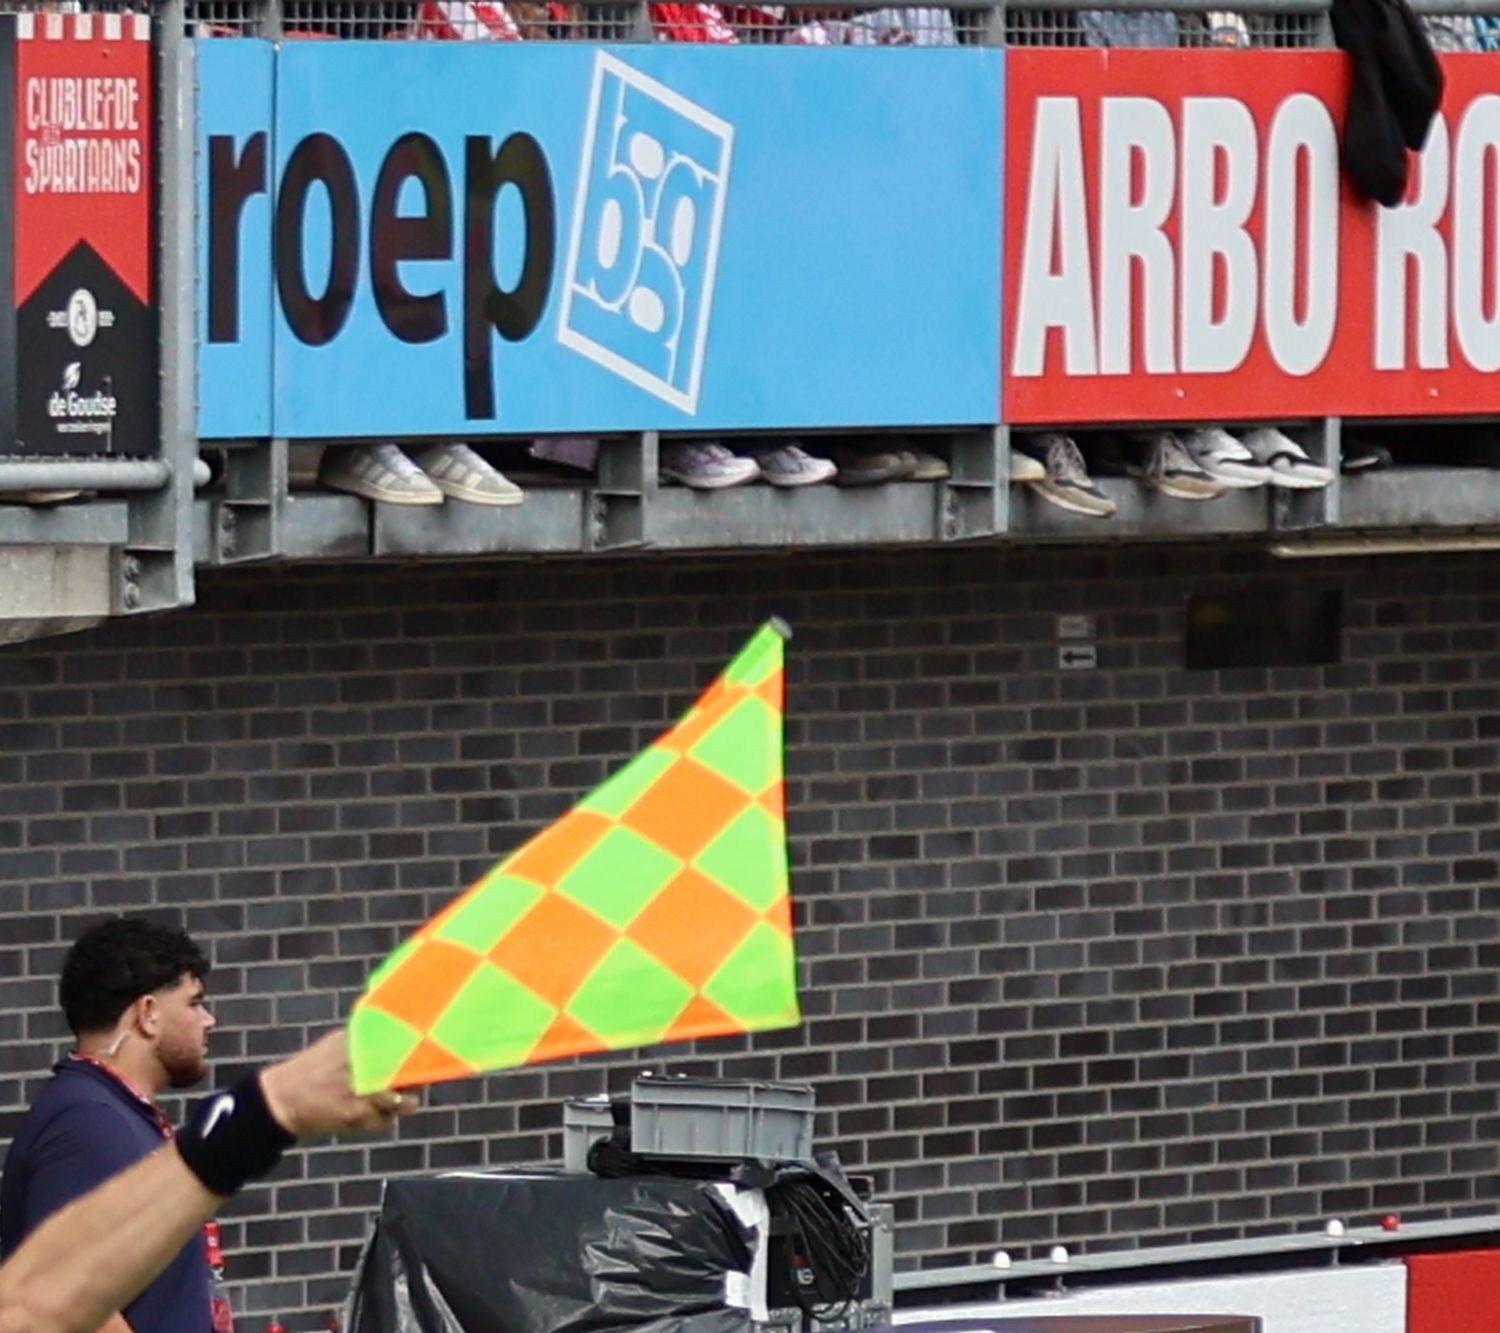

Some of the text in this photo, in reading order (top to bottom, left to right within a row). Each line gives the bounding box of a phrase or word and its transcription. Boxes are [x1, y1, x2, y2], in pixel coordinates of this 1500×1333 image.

[25, 139, 141, 194] SPARTAANS
[207, 130, 556, 421] roep
[1012, 92, 1339, 378] ARBO
